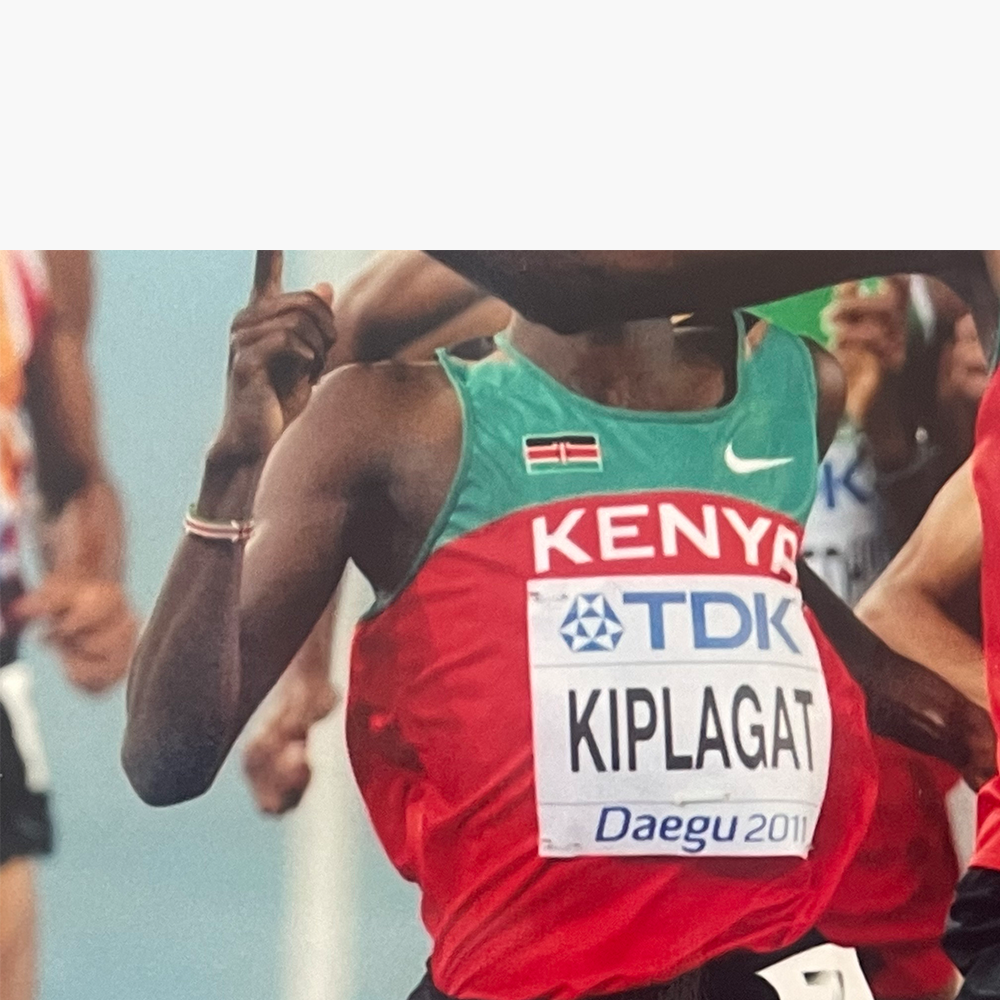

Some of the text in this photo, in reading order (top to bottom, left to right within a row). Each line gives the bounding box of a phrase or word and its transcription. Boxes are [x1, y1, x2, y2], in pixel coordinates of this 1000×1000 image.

[622, 590, 803, 655] TDK
[567, 683, 815, 773] KIPLAGAT
[594, 805, 808, 853] Daegu 2011
